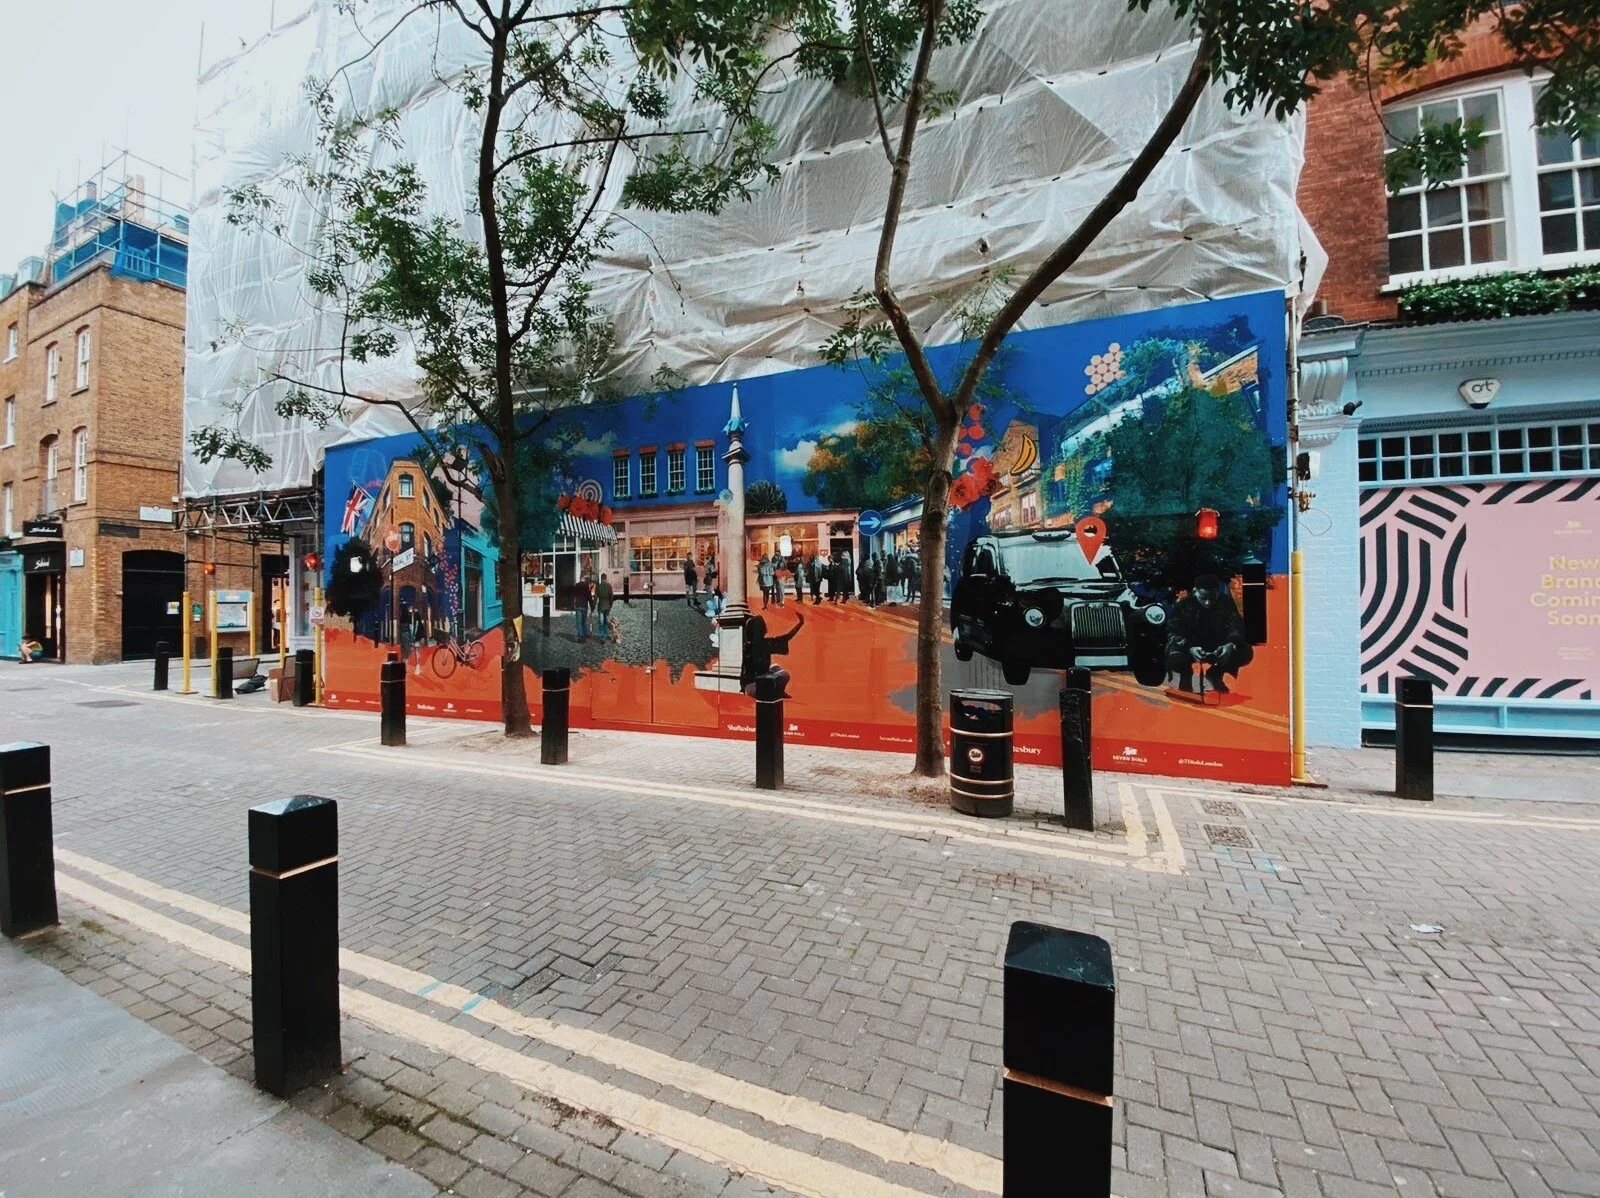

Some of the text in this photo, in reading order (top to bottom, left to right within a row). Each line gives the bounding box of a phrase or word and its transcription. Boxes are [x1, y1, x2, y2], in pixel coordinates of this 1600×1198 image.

[1549, 556, 1600, 570] New
[1529, 591, 1600, 607] Comin
[1547, 610, 1600, 625] Soon
[1012, 745, 1041, 756] tesbury
